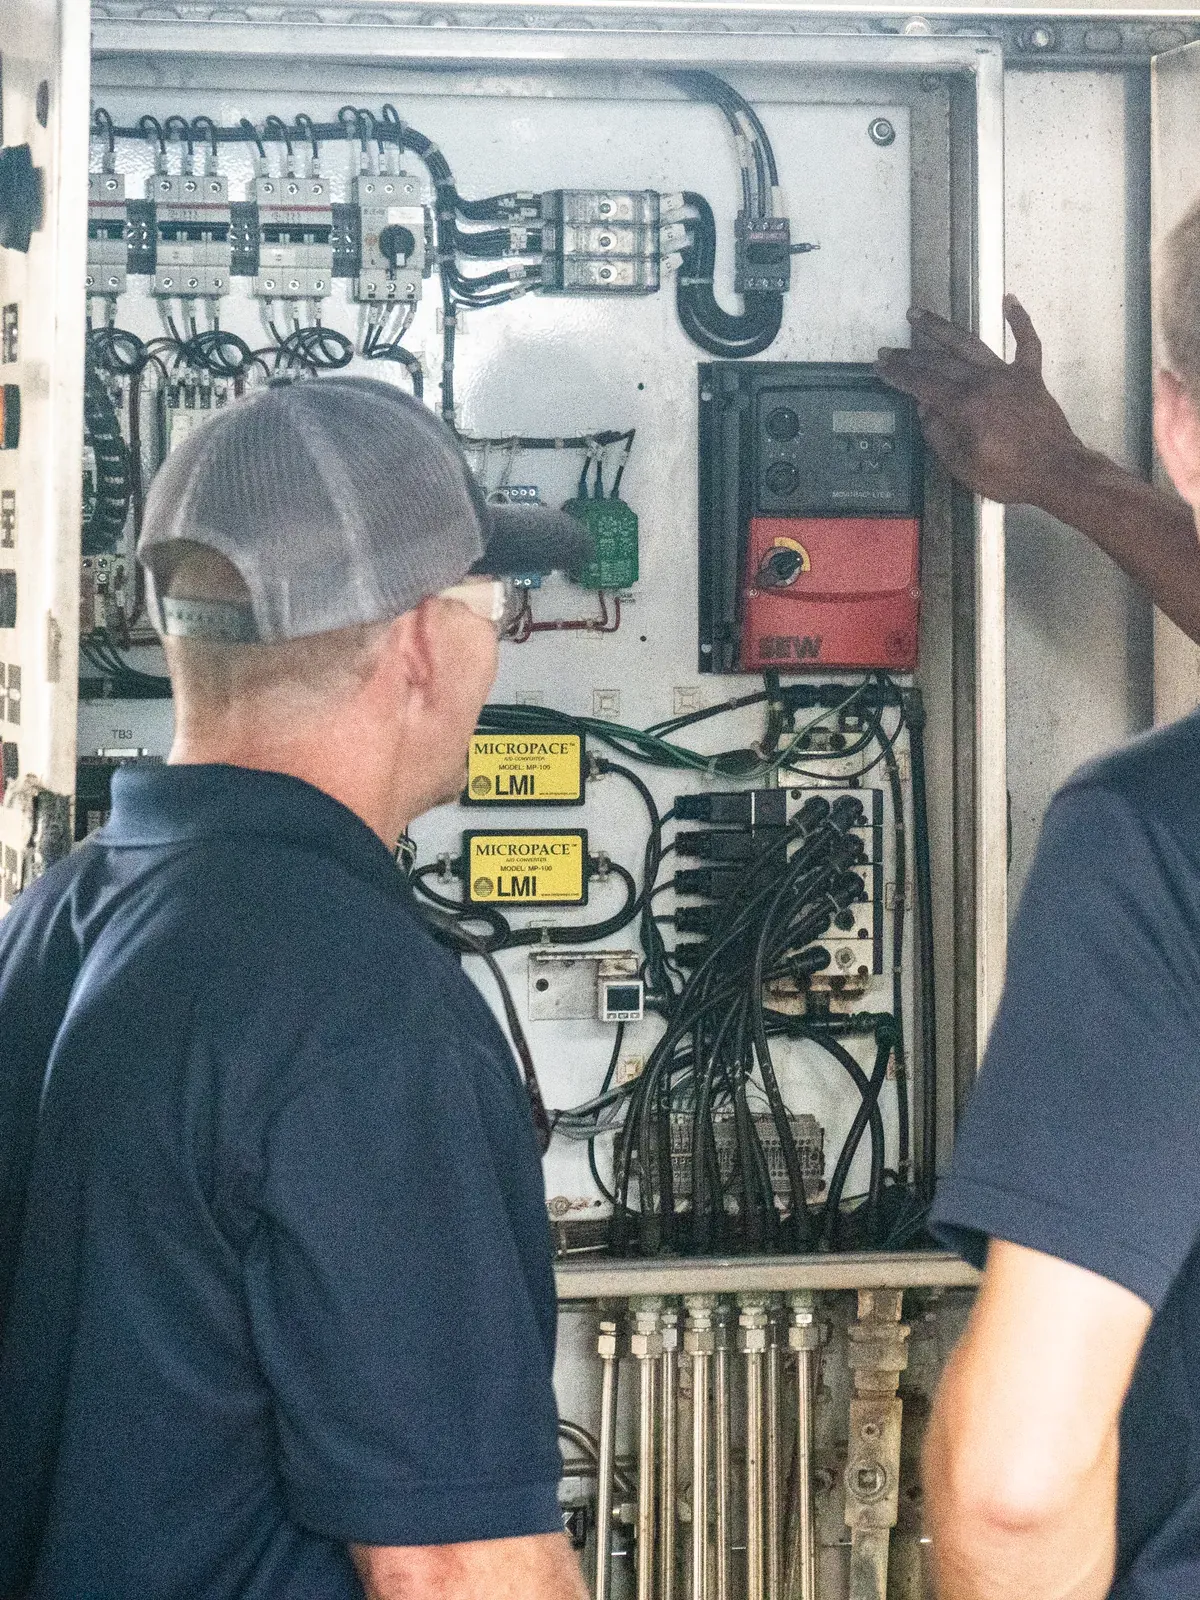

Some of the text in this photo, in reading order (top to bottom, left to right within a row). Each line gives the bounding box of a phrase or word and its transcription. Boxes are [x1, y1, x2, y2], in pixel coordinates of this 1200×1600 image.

[759, 635, 823, 658] SEW
[112, 729, 133, 739] TB3
[495, 774, 535, 795] LMI
[497, 876, 537, 897] LMI
